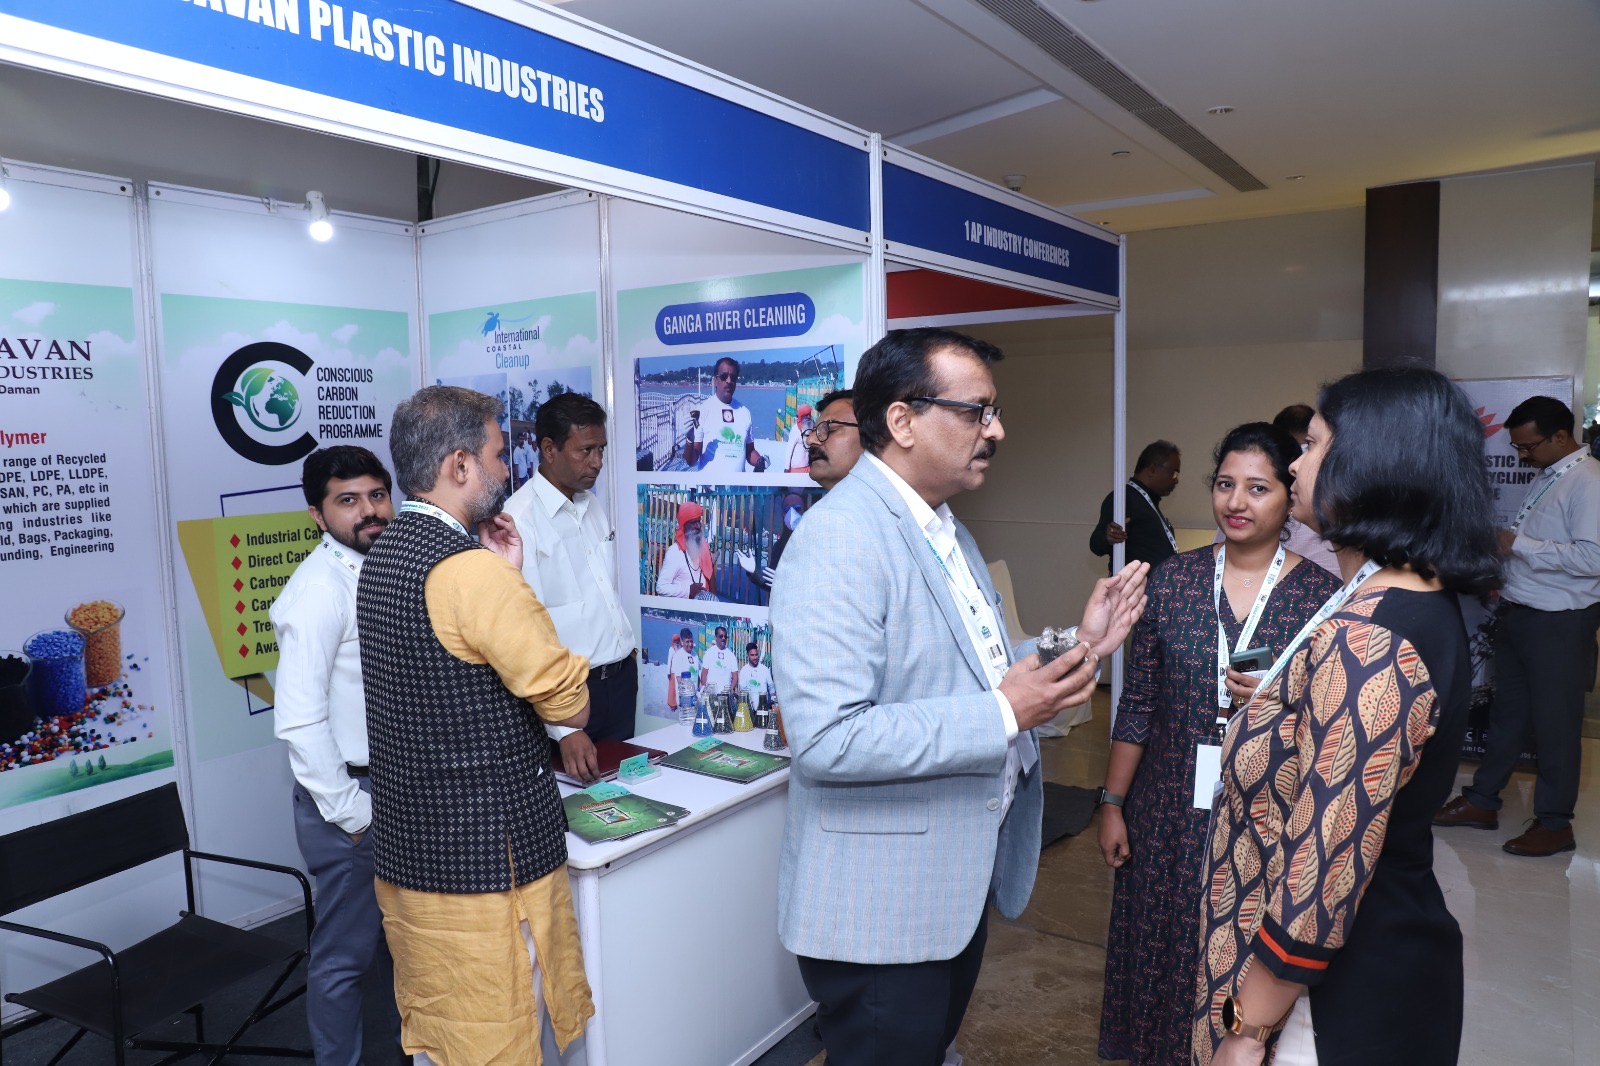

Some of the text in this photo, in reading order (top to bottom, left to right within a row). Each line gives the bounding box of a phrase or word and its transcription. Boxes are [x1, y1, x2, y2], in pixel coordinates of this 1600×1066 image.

[308, 0, 446, 77] PLASTIC
[452, 43, 605, 123] INDUSTRIES
[964, 219, 1070, 268] 1 AP INDUSTRY CONFERENCES
[663, 303, 806, 335] GANGA RIVER CLEANING
[494, 325, 540, 344] International
[486, 343, 522, 353] COASTAL
[495, 353, 530, 370] Cleanup
[316, 367, 373, 383] CONSCIOUS
[317, 386, 359, 401] CARBON
[318, 405, 376, 420] REDUCTION
[319, 423, 383, 439] PROGRAMME
[3, 452, 107, 468] range of Recycled
[30, 470, 64, 481] LDPE,
[69, 467, 108, 480] LLDPE,
[0, 482, 109, 499] SAN, PC, PA, etc in
[3, 496, 110, 514] which are supplied
[22, 514, 83, 529] industries
[91, 511, 112, 523] like
[18, 533, 51, 545] Bags,
[54, 527, 113, 541] Packaging,
[246, 528, 301, 546] Industrial
[50, 541, 114, 557] Engineering
[248, 555, 283, 569] Direct
